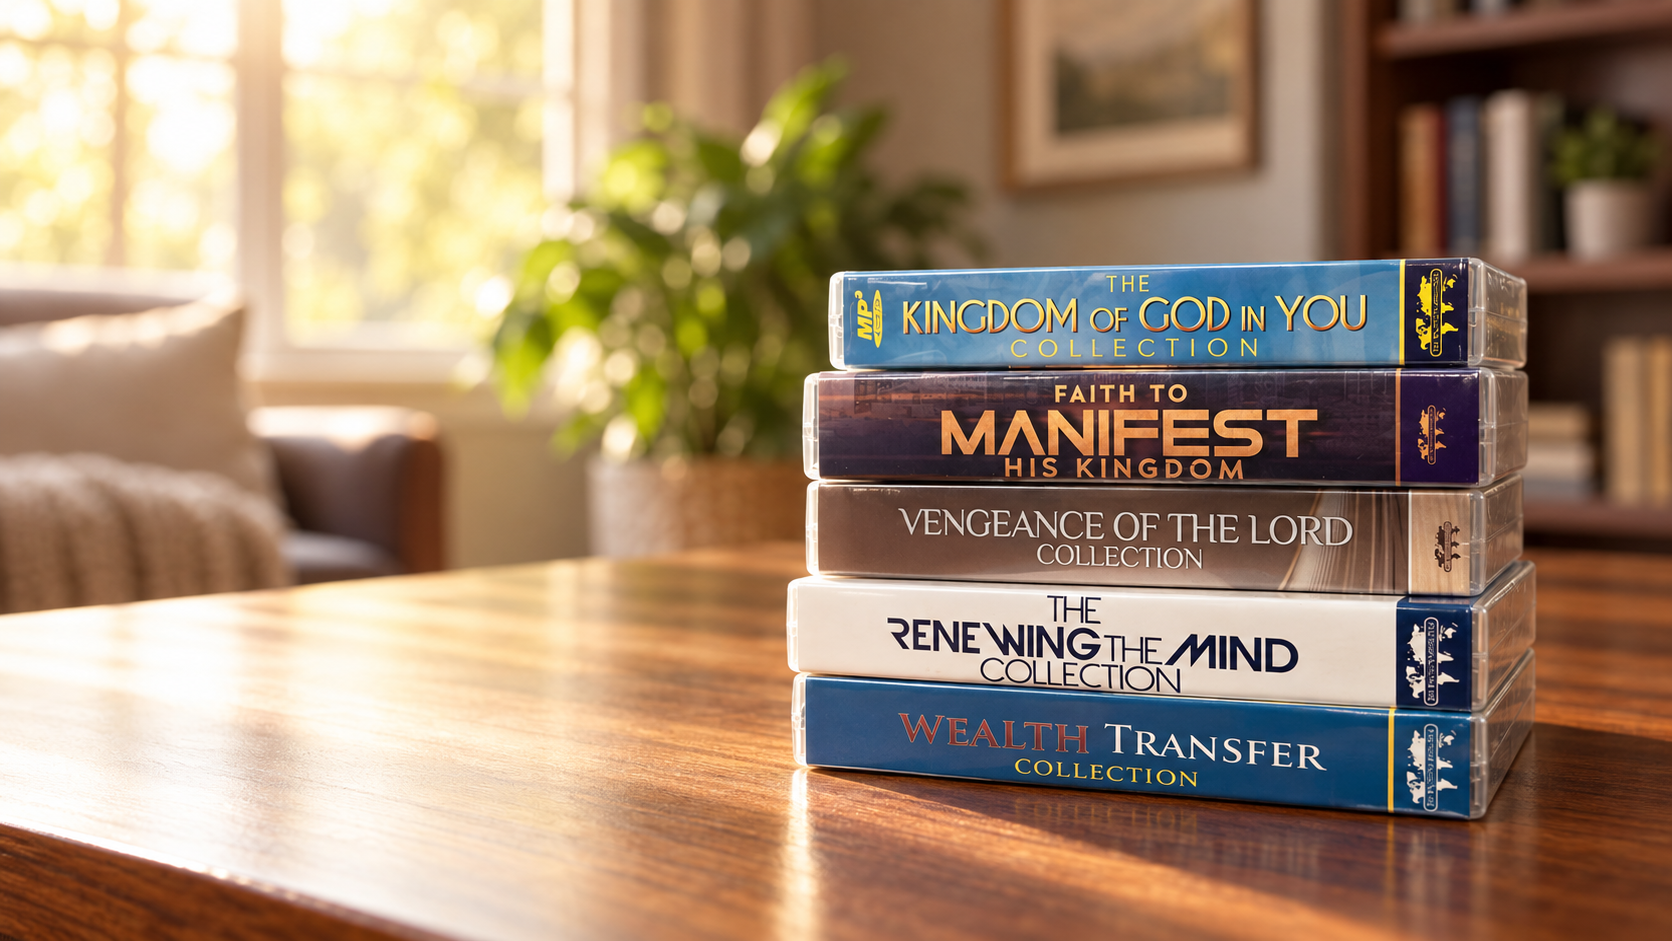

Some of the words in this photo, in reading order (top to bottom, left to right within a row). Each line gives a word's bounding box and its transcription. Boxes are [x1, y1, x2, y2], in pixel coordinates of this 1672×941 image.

[1106, 274, 1150, 293] THE
[903, 298, 1079, 334] KINGDOM
[1089, 307, 1129, 333] OF
[1139, 296, 1231, 333] GOD
[1241, 306, 1266, 332] IN
[1274, 294, 1368, 332] YOU
[1010, 338, 1258, 358] COLLECTION
[1054, 384, 1135, 403] FAITH
[1149, 383, 1188, 403] TO
[941, 409, 1318, 457] MANIFEST
[1004, 457, 1058, 479] HIS
[1076, 457, 1244, 480] KINGDOM
[898, 508, 1105, 540] VENGEANCE
[1113, 511, 1160, 542] OF
[1167, 513, 1240, 543] THE
[1248, 514, 1354, 546] LORD
[1036, 543, 1203, 569] COLLECTION
[1047, 595, 1102, 624] THE
[887, 617, 1102, 661] RENEWING
[1103, 634, 1163, 665] THE
[1164, 633, 1299, 673] MIND
[980, 657, 1181, 693] COLLECTION
[898, 713, 1090, 754] WEALTH
[1104, 723, 1328, 771] TRANSFER
[1014, 758, 1198, 787] COLLECTION
